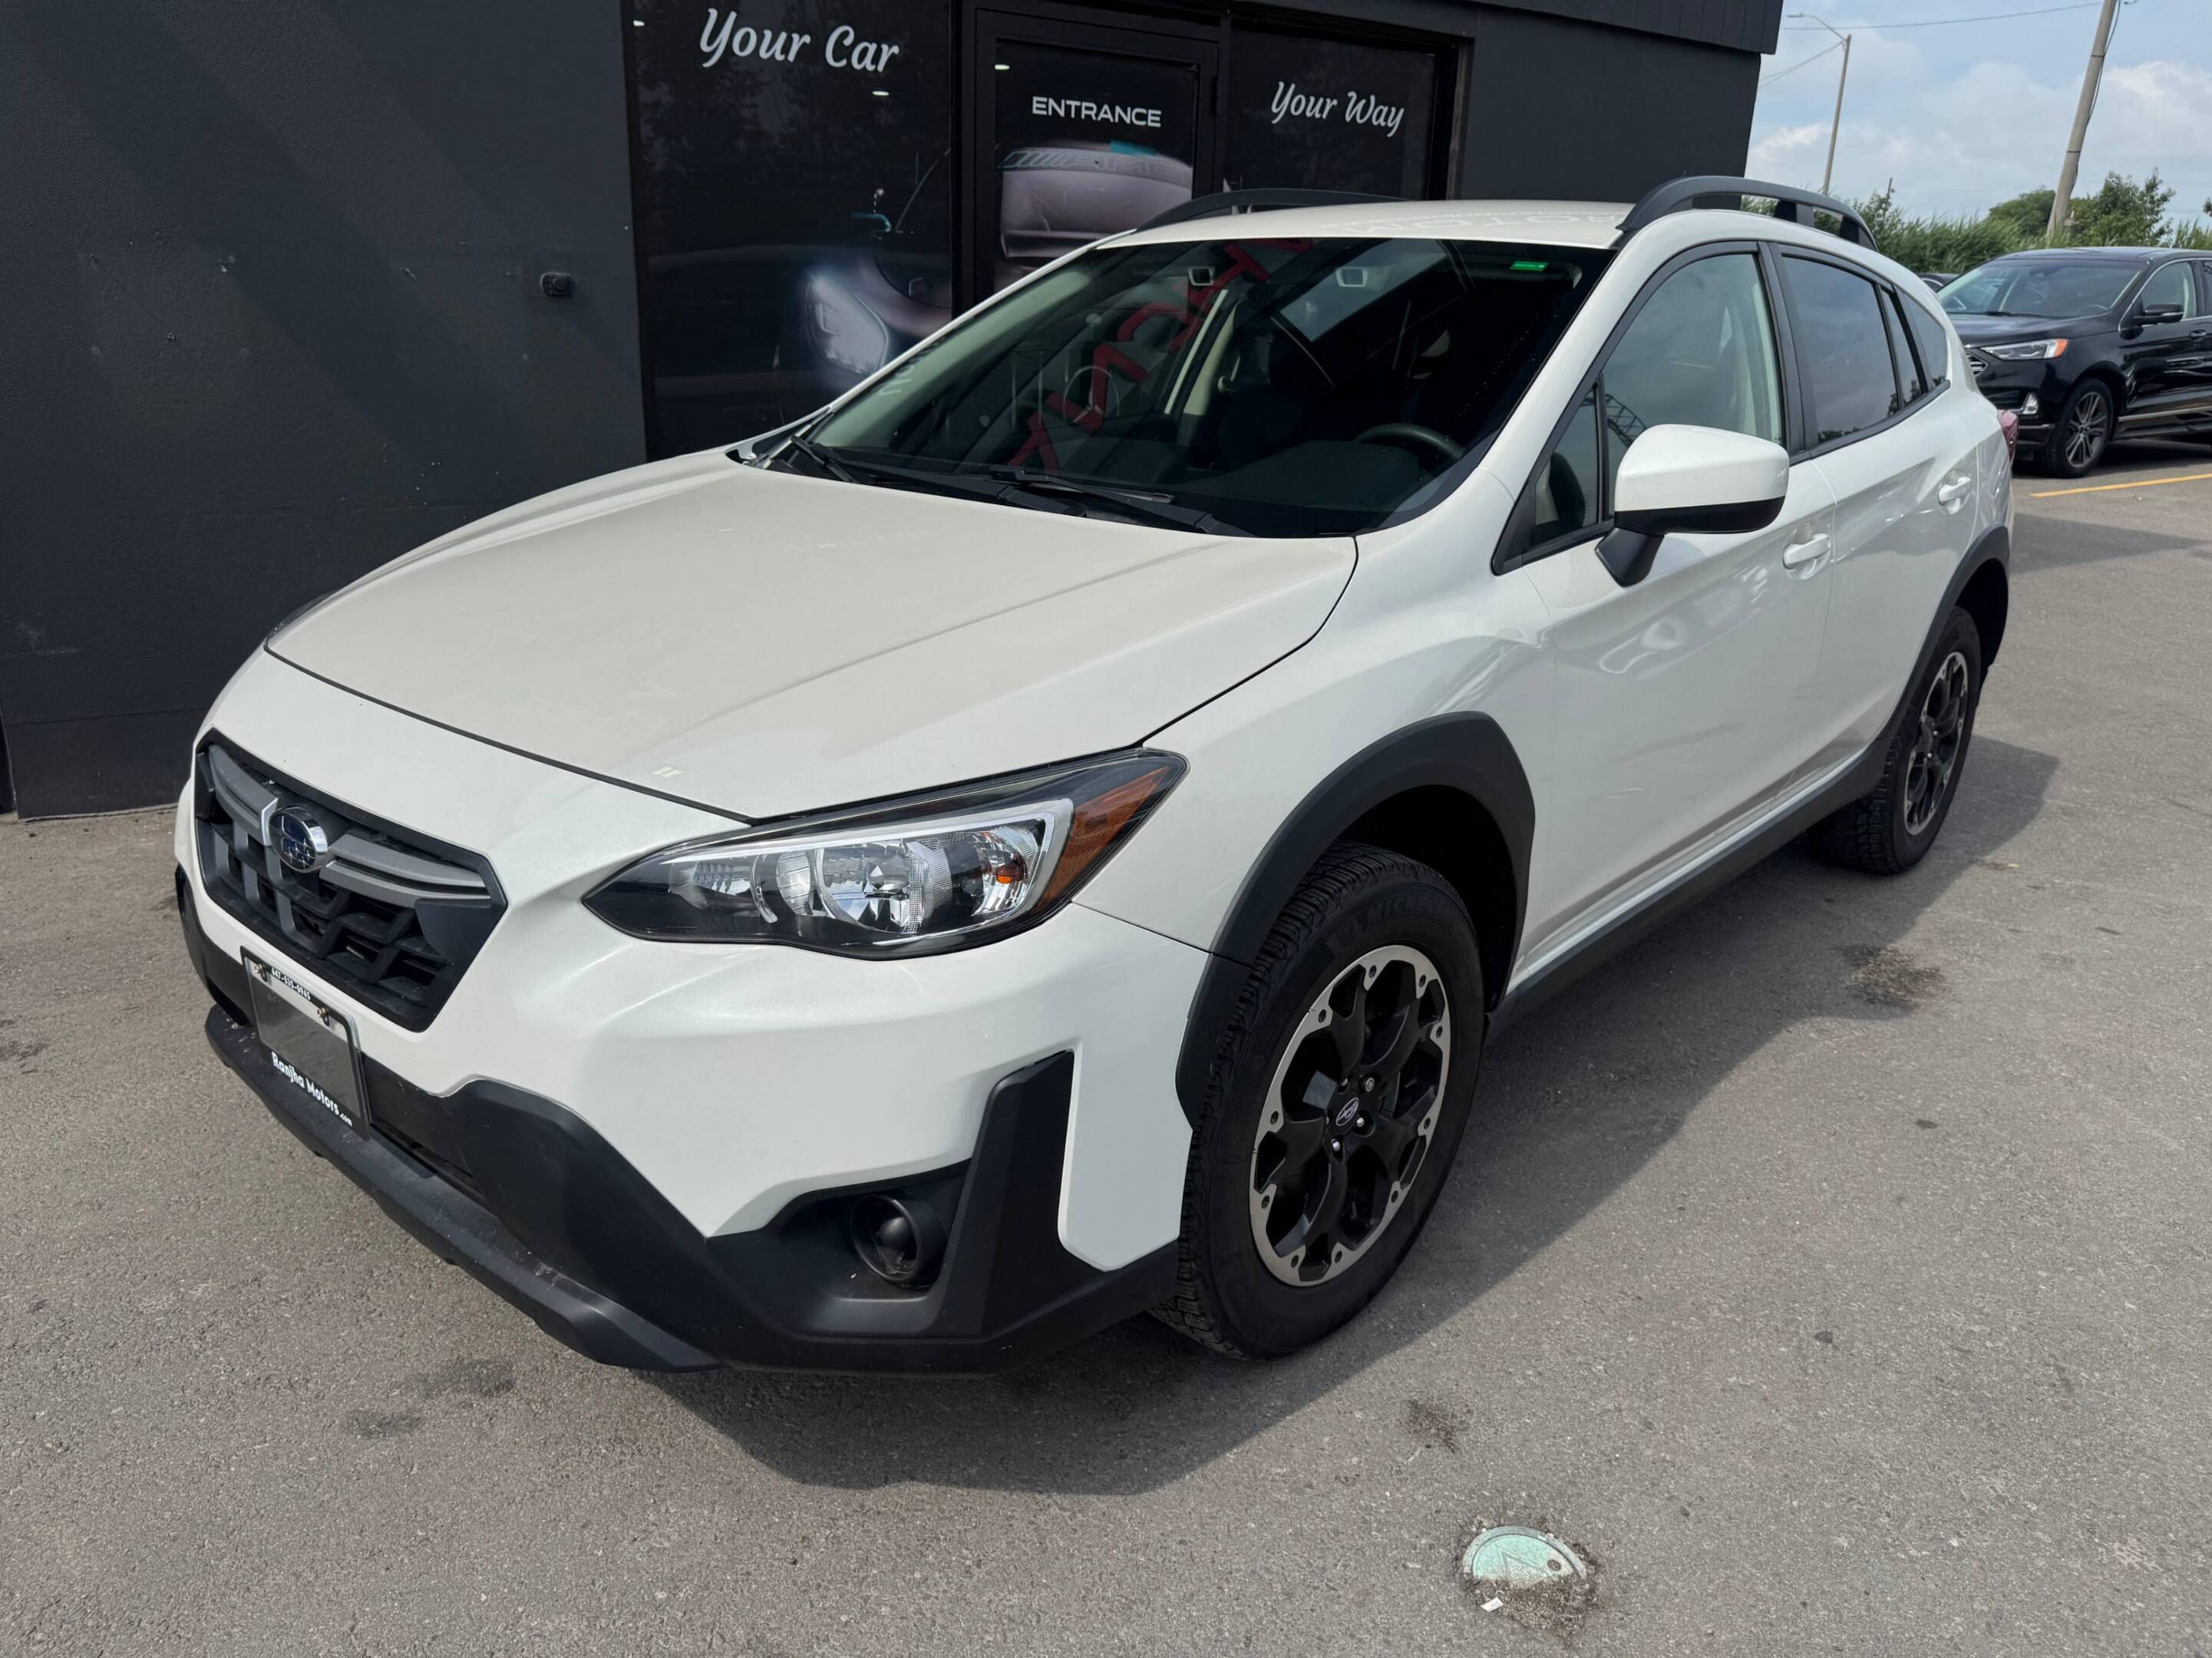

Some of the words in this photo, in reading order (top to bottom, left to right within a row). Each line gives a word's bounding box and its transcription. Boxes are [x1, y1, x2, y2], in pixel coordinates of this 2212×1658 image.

[700, 8, 811, 68] Your
[825, 25, 900, 72] Car
[1032, 96, 1161, 127] ENTRANCE
[1271, 81, 1338, 124] Your
[1345, 91, 1405, 137] Way
[271, 1051, 305, 1089] Ranjha
[305, 1077, 340, 1116] Motors
